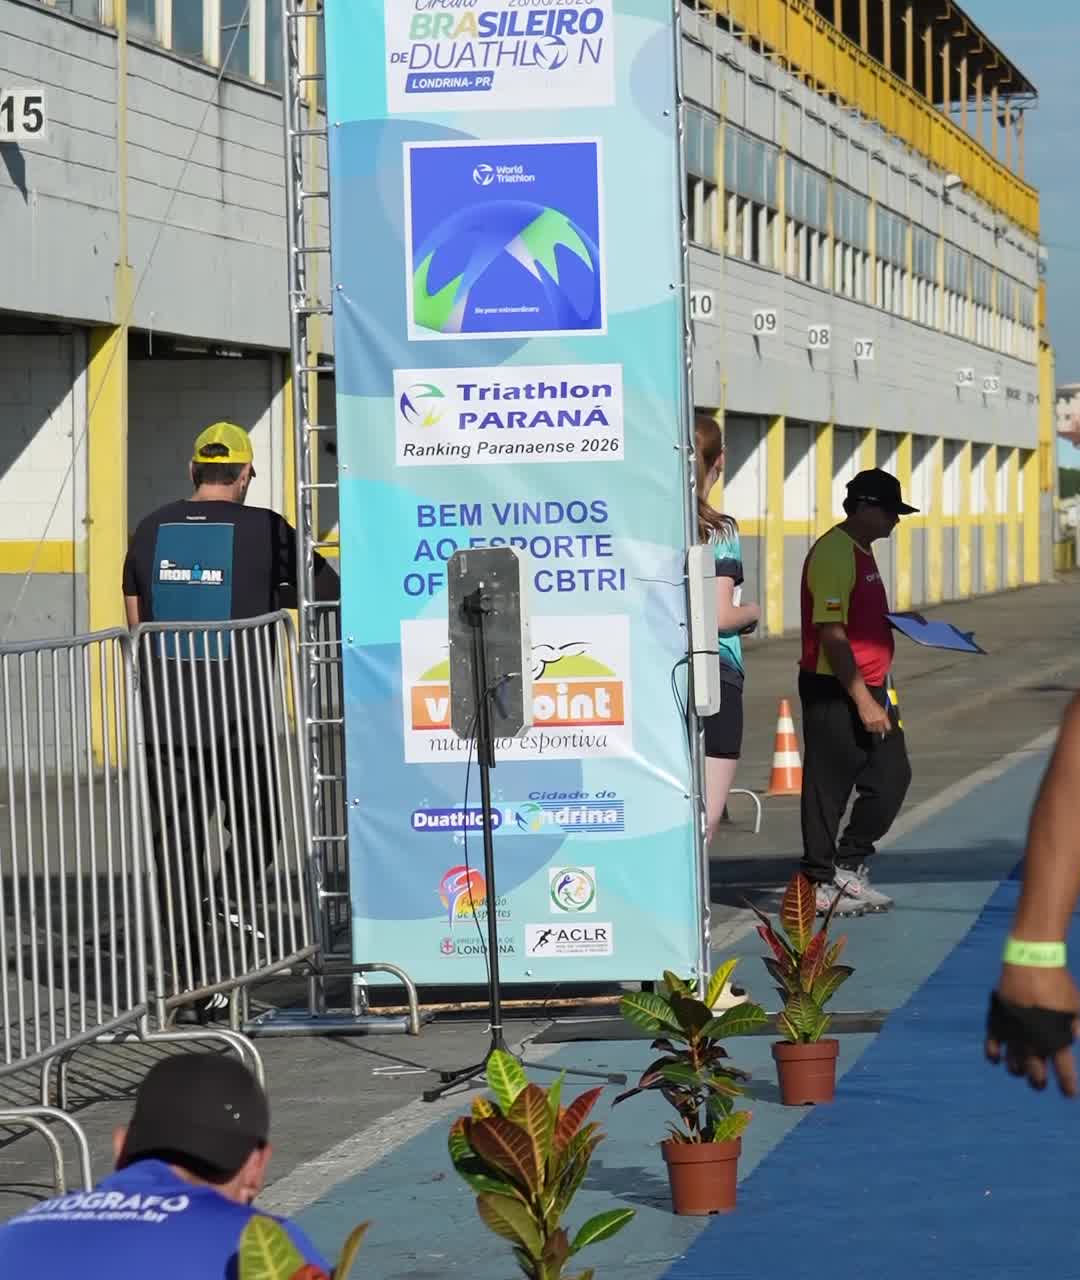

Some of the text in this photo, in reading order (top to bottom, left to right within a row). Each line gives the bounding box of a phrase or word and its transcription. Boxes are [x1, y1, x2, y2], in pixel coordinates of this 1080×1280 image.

[409, 7, 604, 40] BRASILEIRO
[390, 52, 408, 64] DE
[475, 76, 490, 87] PR
[1, 96, 43, 133] 15
[496, 165, 523, 174] World
[496, 173, 535, 183] Triathlon
[689, 296, 712, 313] 10
[754, 314, 776, 331] 09
[808, 329, 829, 345] 08
[855, 343, 873, 357] 07
[456, 382, 612, 401] Triathlon
[458, 405, 609, 430] PARANÁ
[403, 438, 619, 458] Ranking Paranaense 2026
[417, 500, 609, 527] BEM VINDOS
[414, 538, 457, 562] AO
[534, 568, 625, 593] CBTRI
[520, 730, 608, 754] esportiva
[528, 790, 617, 800] Cidade de
[557, 928, 607, 941] ACLR
[457, 945, 515, 955] LONDNA
